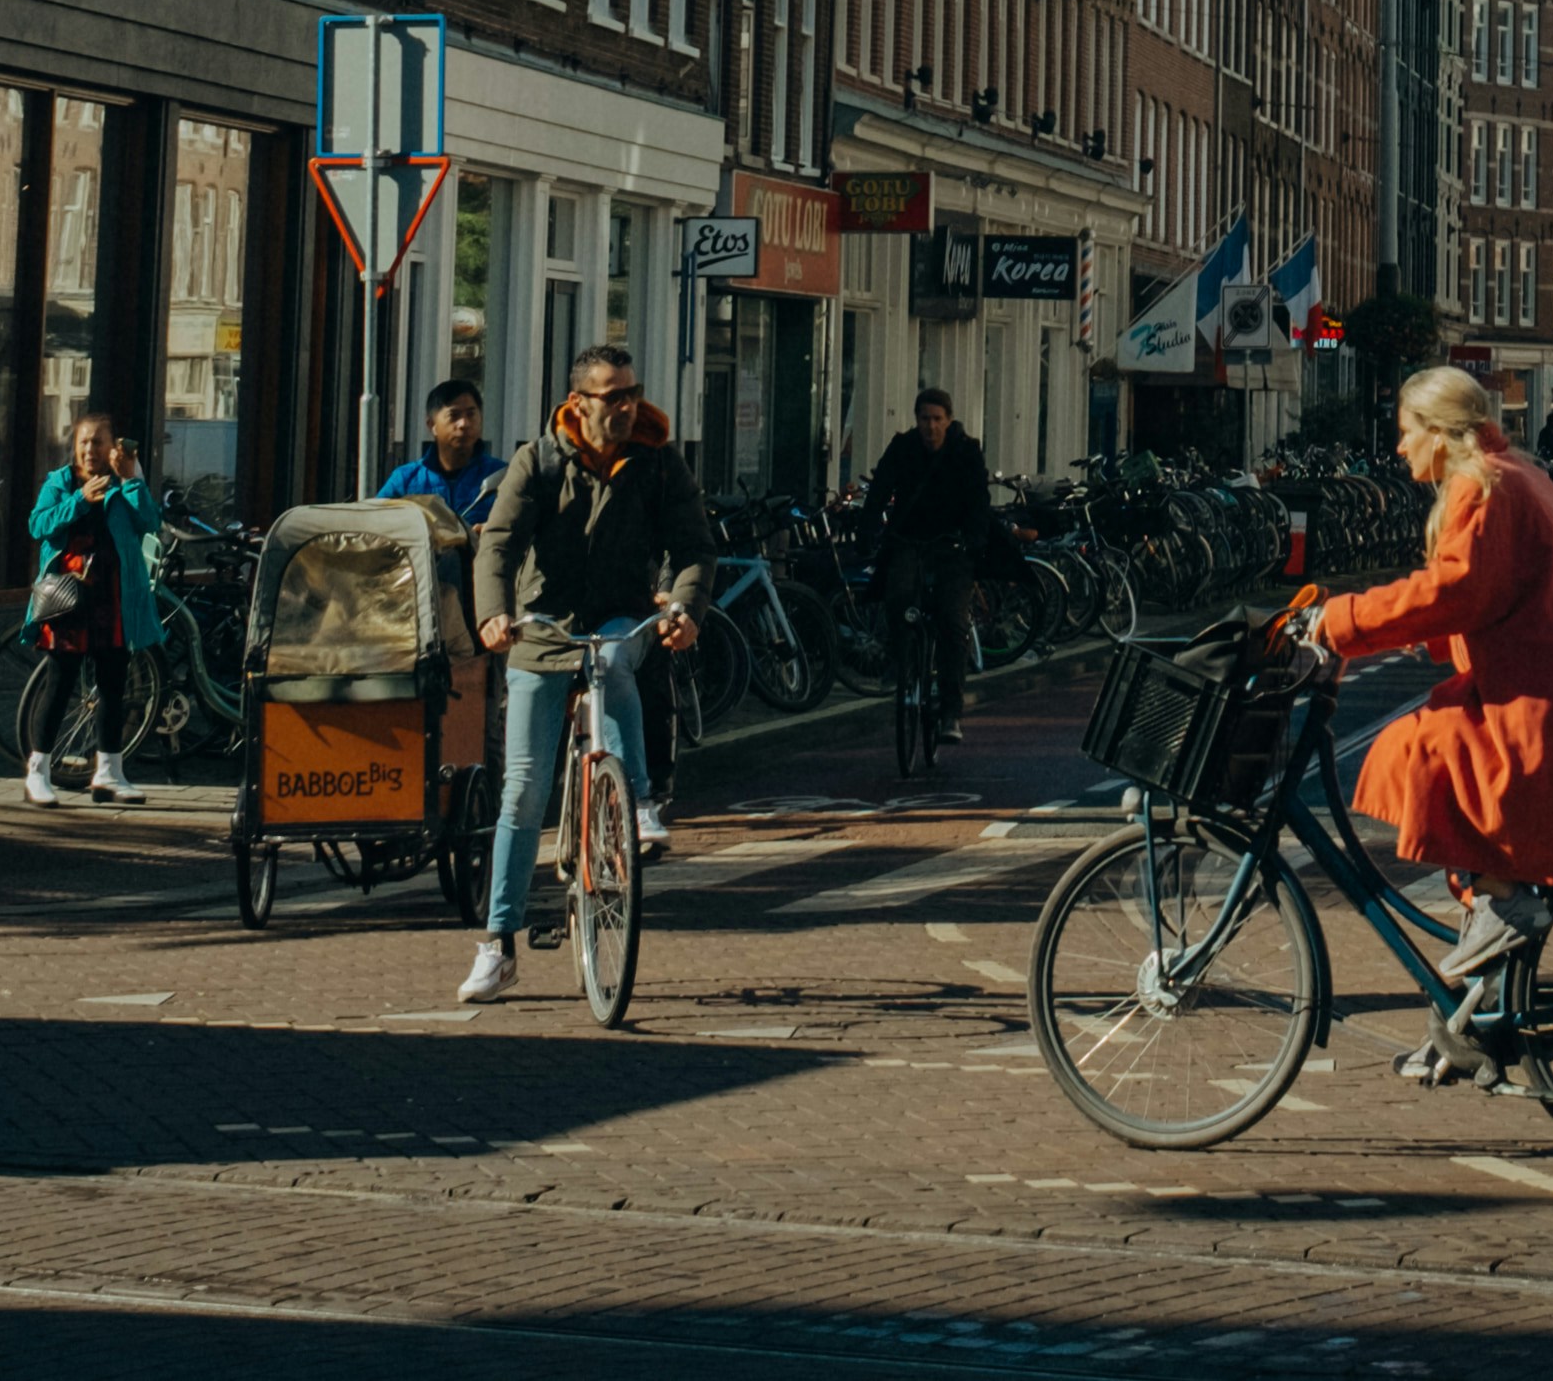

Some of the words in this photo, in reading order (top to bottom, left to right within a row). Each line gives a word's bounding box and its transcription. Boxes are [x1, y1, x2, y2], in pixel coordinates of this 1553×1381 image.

[694, 224, 750, 256] Etos
[794, 197, 828, 253] LOBI
[991, 255, 1070, 286] Korea
[277, 771, 374, 798] BABBOE
[370, 761, 404, 791] Big
